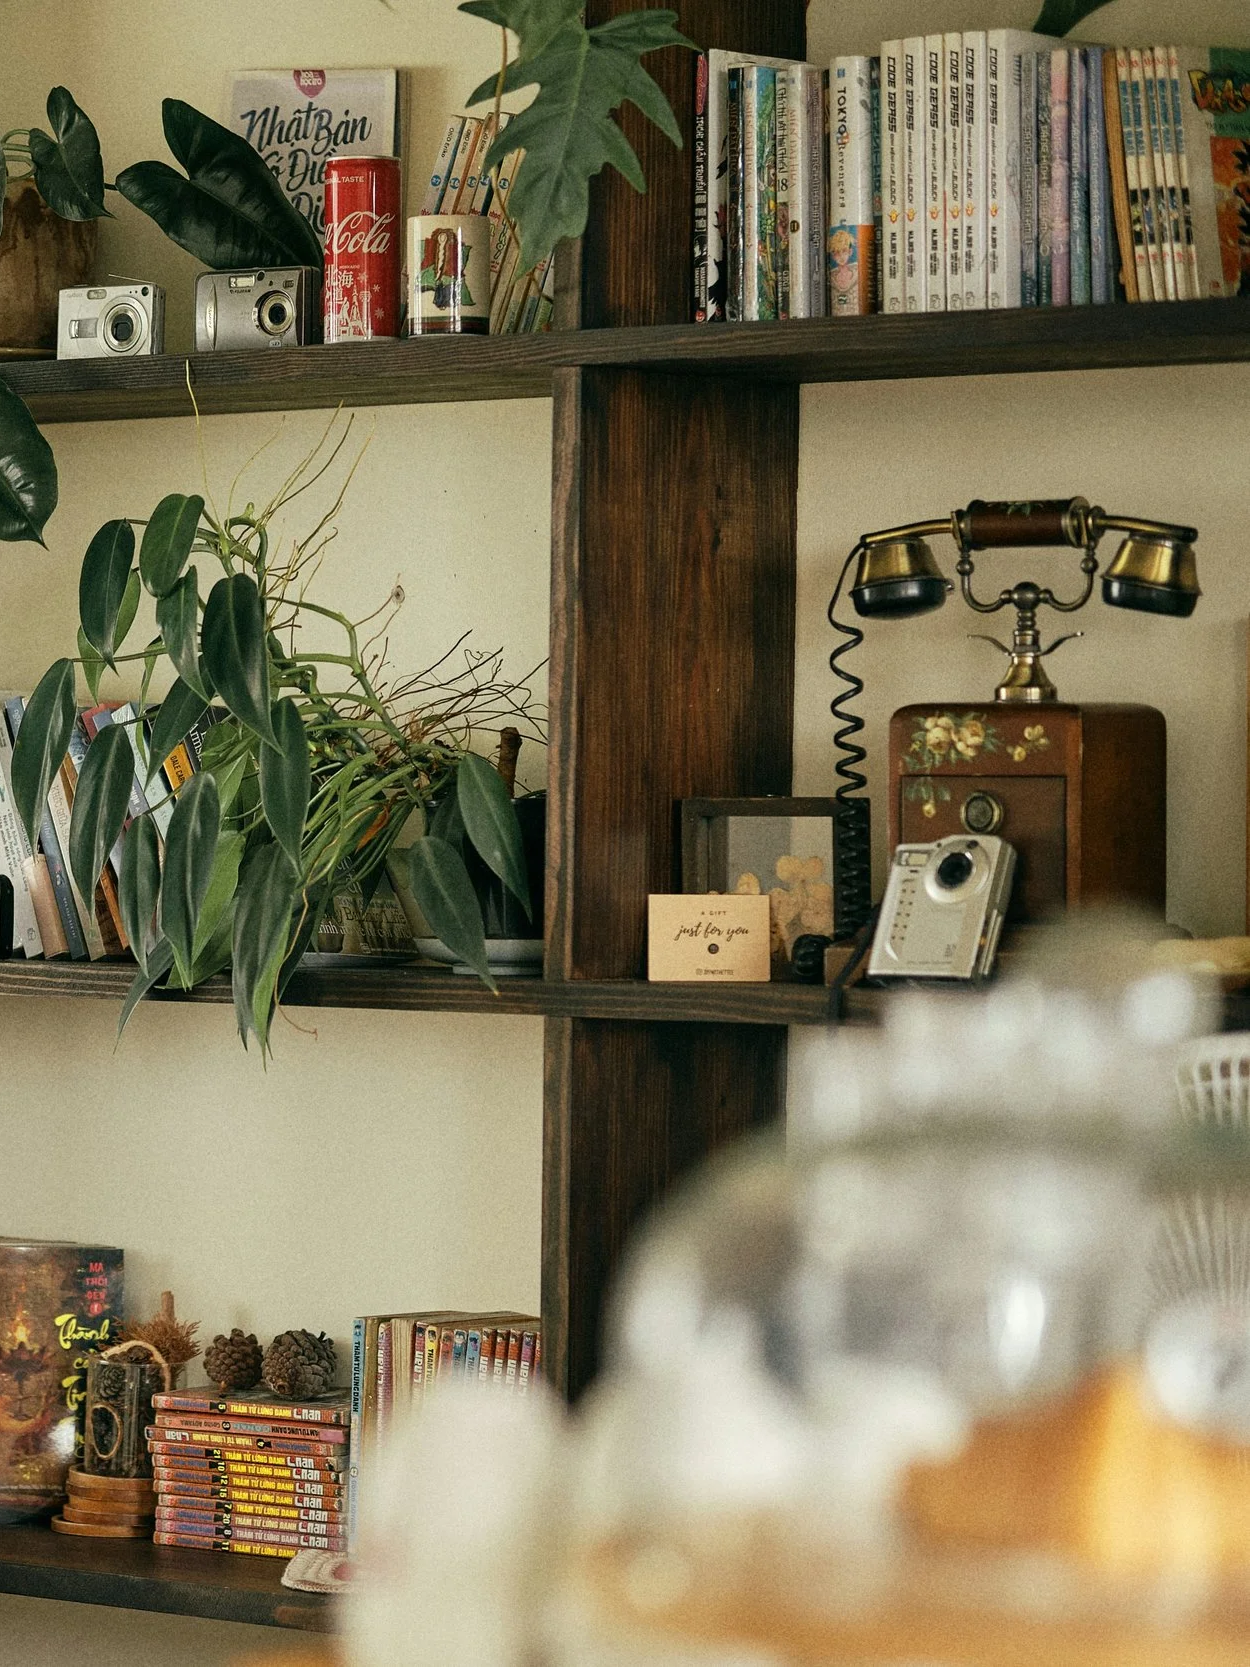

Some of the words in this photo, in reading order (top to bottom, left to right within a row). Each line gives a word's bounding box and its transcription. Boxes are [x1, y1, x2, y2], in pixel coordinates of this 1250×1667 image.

[887, 56, 896, 89] CODE
[905, 54, 914, 87] CODE
[929, 51, 938, 84] CODE
[950, 50, 959, 83] CODE
[966, 47, 974, 80] CODE
[990, 47, 998, 80] CODE
[837, 87, 846, 135] TOKYO
[888, 92, 897, 133] GEASS
[906, 90, 914, 131] GEASS
[930, 87, 938, 128] GEASS
[950, 86, 959, 128] GEASS
[966, 83, 974, 125] GEASS
[990, 83, 998, 125] GEASS
[342, 175, 364, 183] TASTE
[838, 143, 846, 208] Revengers
[170, 755, 180, 769] DALE
[674, 921, 703, 942] just
[703, 922, 725, 939] for
[726, 926, 750, 942] you
[89, 1262, 104, 1272] MA
[275, 1408, 292, 1418] DANH
[293, 1408, 321, 1420] Conan
[165, 1430, 190, 1441] Conan
[192, 1433, 210, 1442] DANH
[214, 1449, 221, 1459] 21
[269, 1456, 285, 1465] DANH
[287, 1456, 314, 1468] Conan
[217, 1461, 225, 1472] 10
[274, 1468, 291, 1477] DANH
[292, 1468, 320, 1480] Conan
[220, 1475, 228, 1485] 12
[277, 1482, 294, 1491] DANH
[296, 1482, 323, 1495] Conan
[219, 1488, 227, 1498] 15
[276, 1496, 293, 1505] DANH
[295, 1496, 322, 1508] Conan
[223, 1513, 230, 1524] 20
[279, 1522, 296, 1530] DANH
[298, 1522, 326, 1534] Conan
[281, 1509, 298, 1518] DANH
[300, 1509, 328, 1521] Conan
[221, 1541, 229, 1551] 11
[278, 1549, 296, 1558] DANH
[281, 1535, 298, 1544] DANH
[300, 1535, 328, 1548] Conan
